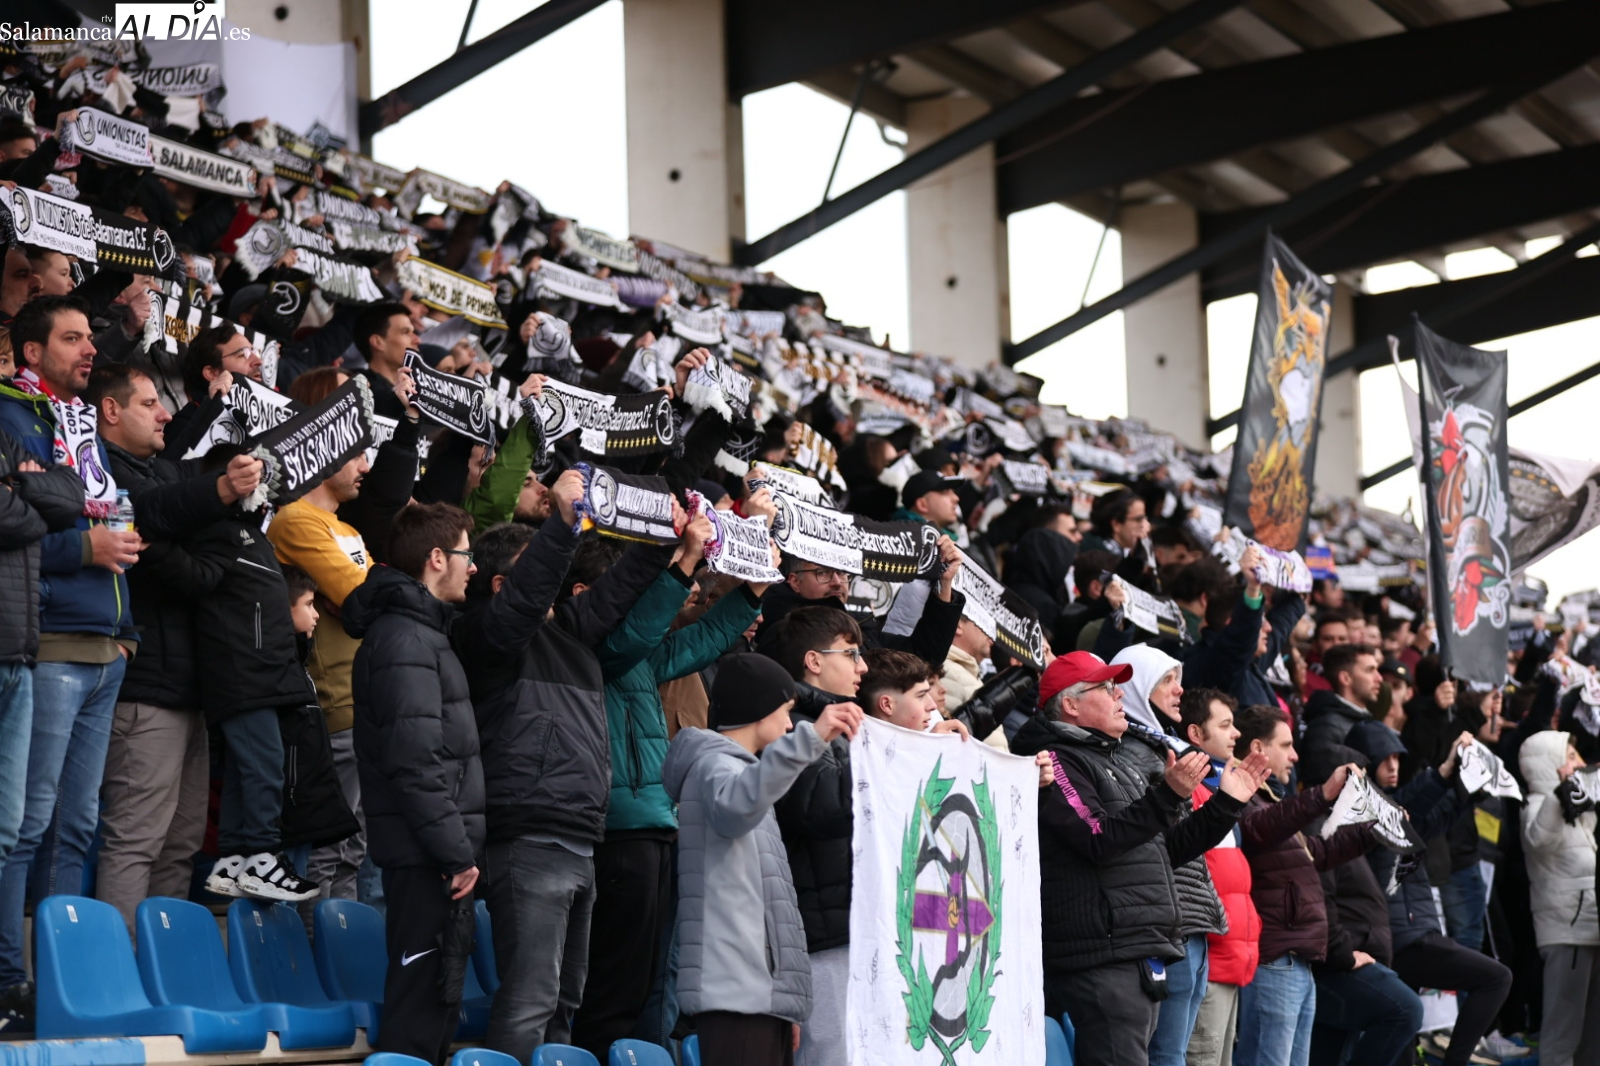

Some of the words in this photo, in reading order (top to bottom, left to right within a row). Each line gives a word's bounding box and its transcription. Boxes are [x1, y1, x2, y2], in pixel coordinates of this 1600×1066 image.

[97, 117, 147, 149] UNIONISTAS
[160, 147, 243, 187] SALAMANCA
[34, 196, 80, 238] UNIONISTAS
[90, 216, 135, 249] Salamanca
[65, 404, 78, 435] COPA
[301, 421, 318, 437] CLUB
[317, 399, 348, 428] SALAMANCA
[606, 405, 642, 431] Salamanca
[283, 406, 364, 490] UNIONISTAS
[793, 502, 847, 546] UNIONISTAS
[856, 525, 901, 556] Salamanca
[728, 540, 737, 558] DE
